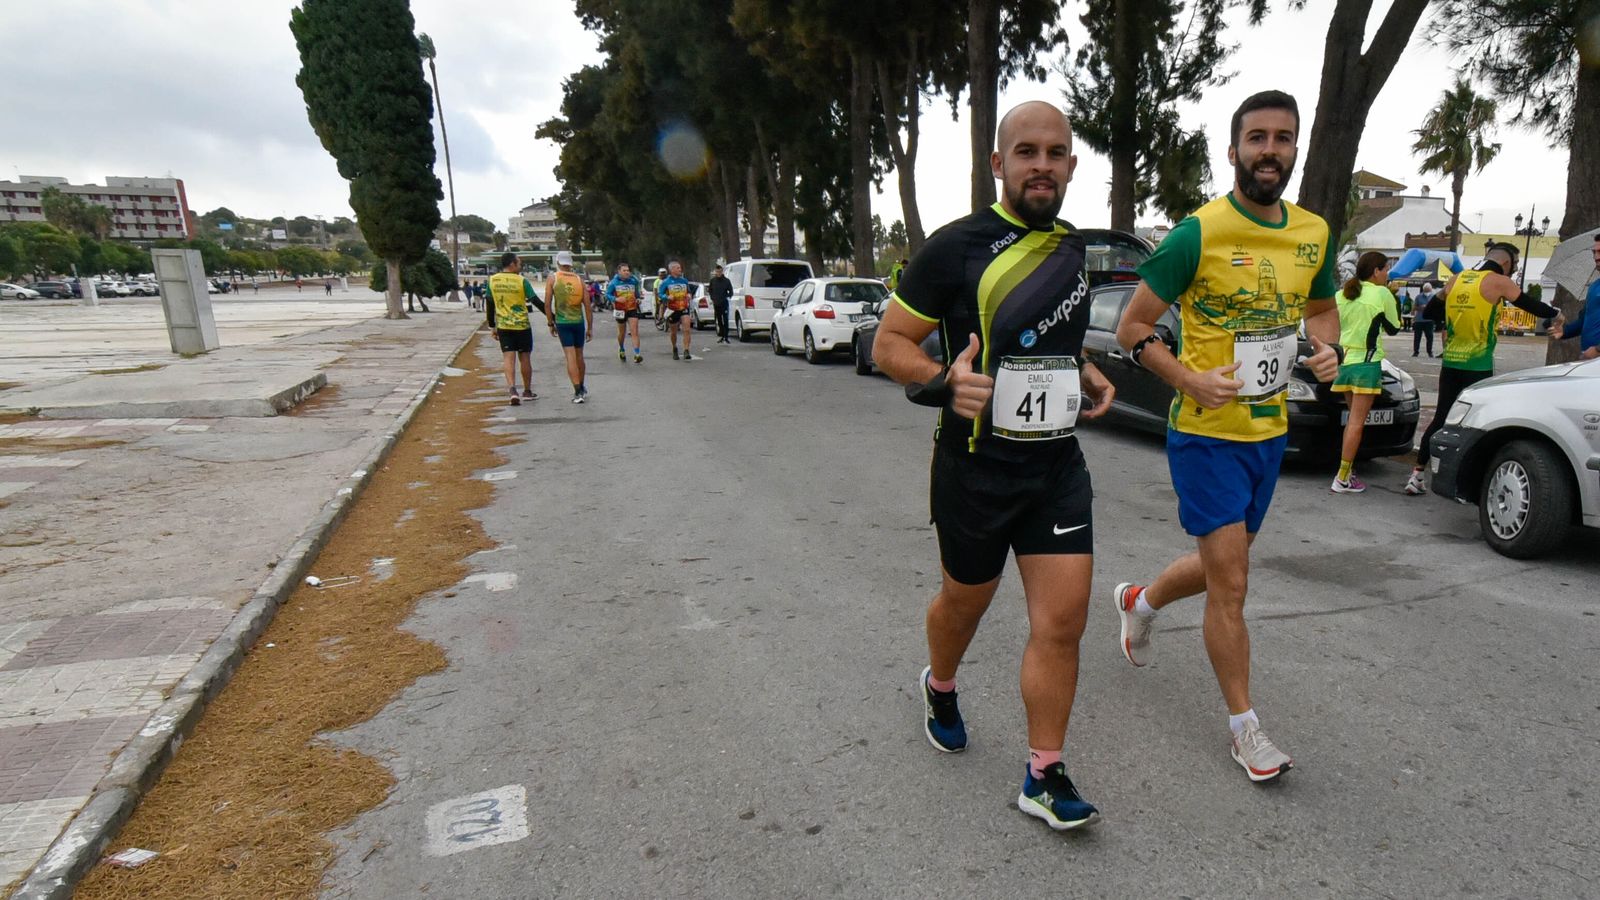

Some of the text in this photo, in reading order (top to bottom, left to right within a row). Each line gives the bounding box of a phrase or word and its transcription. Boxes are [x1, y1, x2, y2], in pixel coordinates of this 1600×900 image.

[1027, 374, 1053, 384] EMILIO
[1257, 357, 1279, 387] 39
[1016, 391, 1046, 422] 41
[1373, 410, 1392, 423] GKJ
